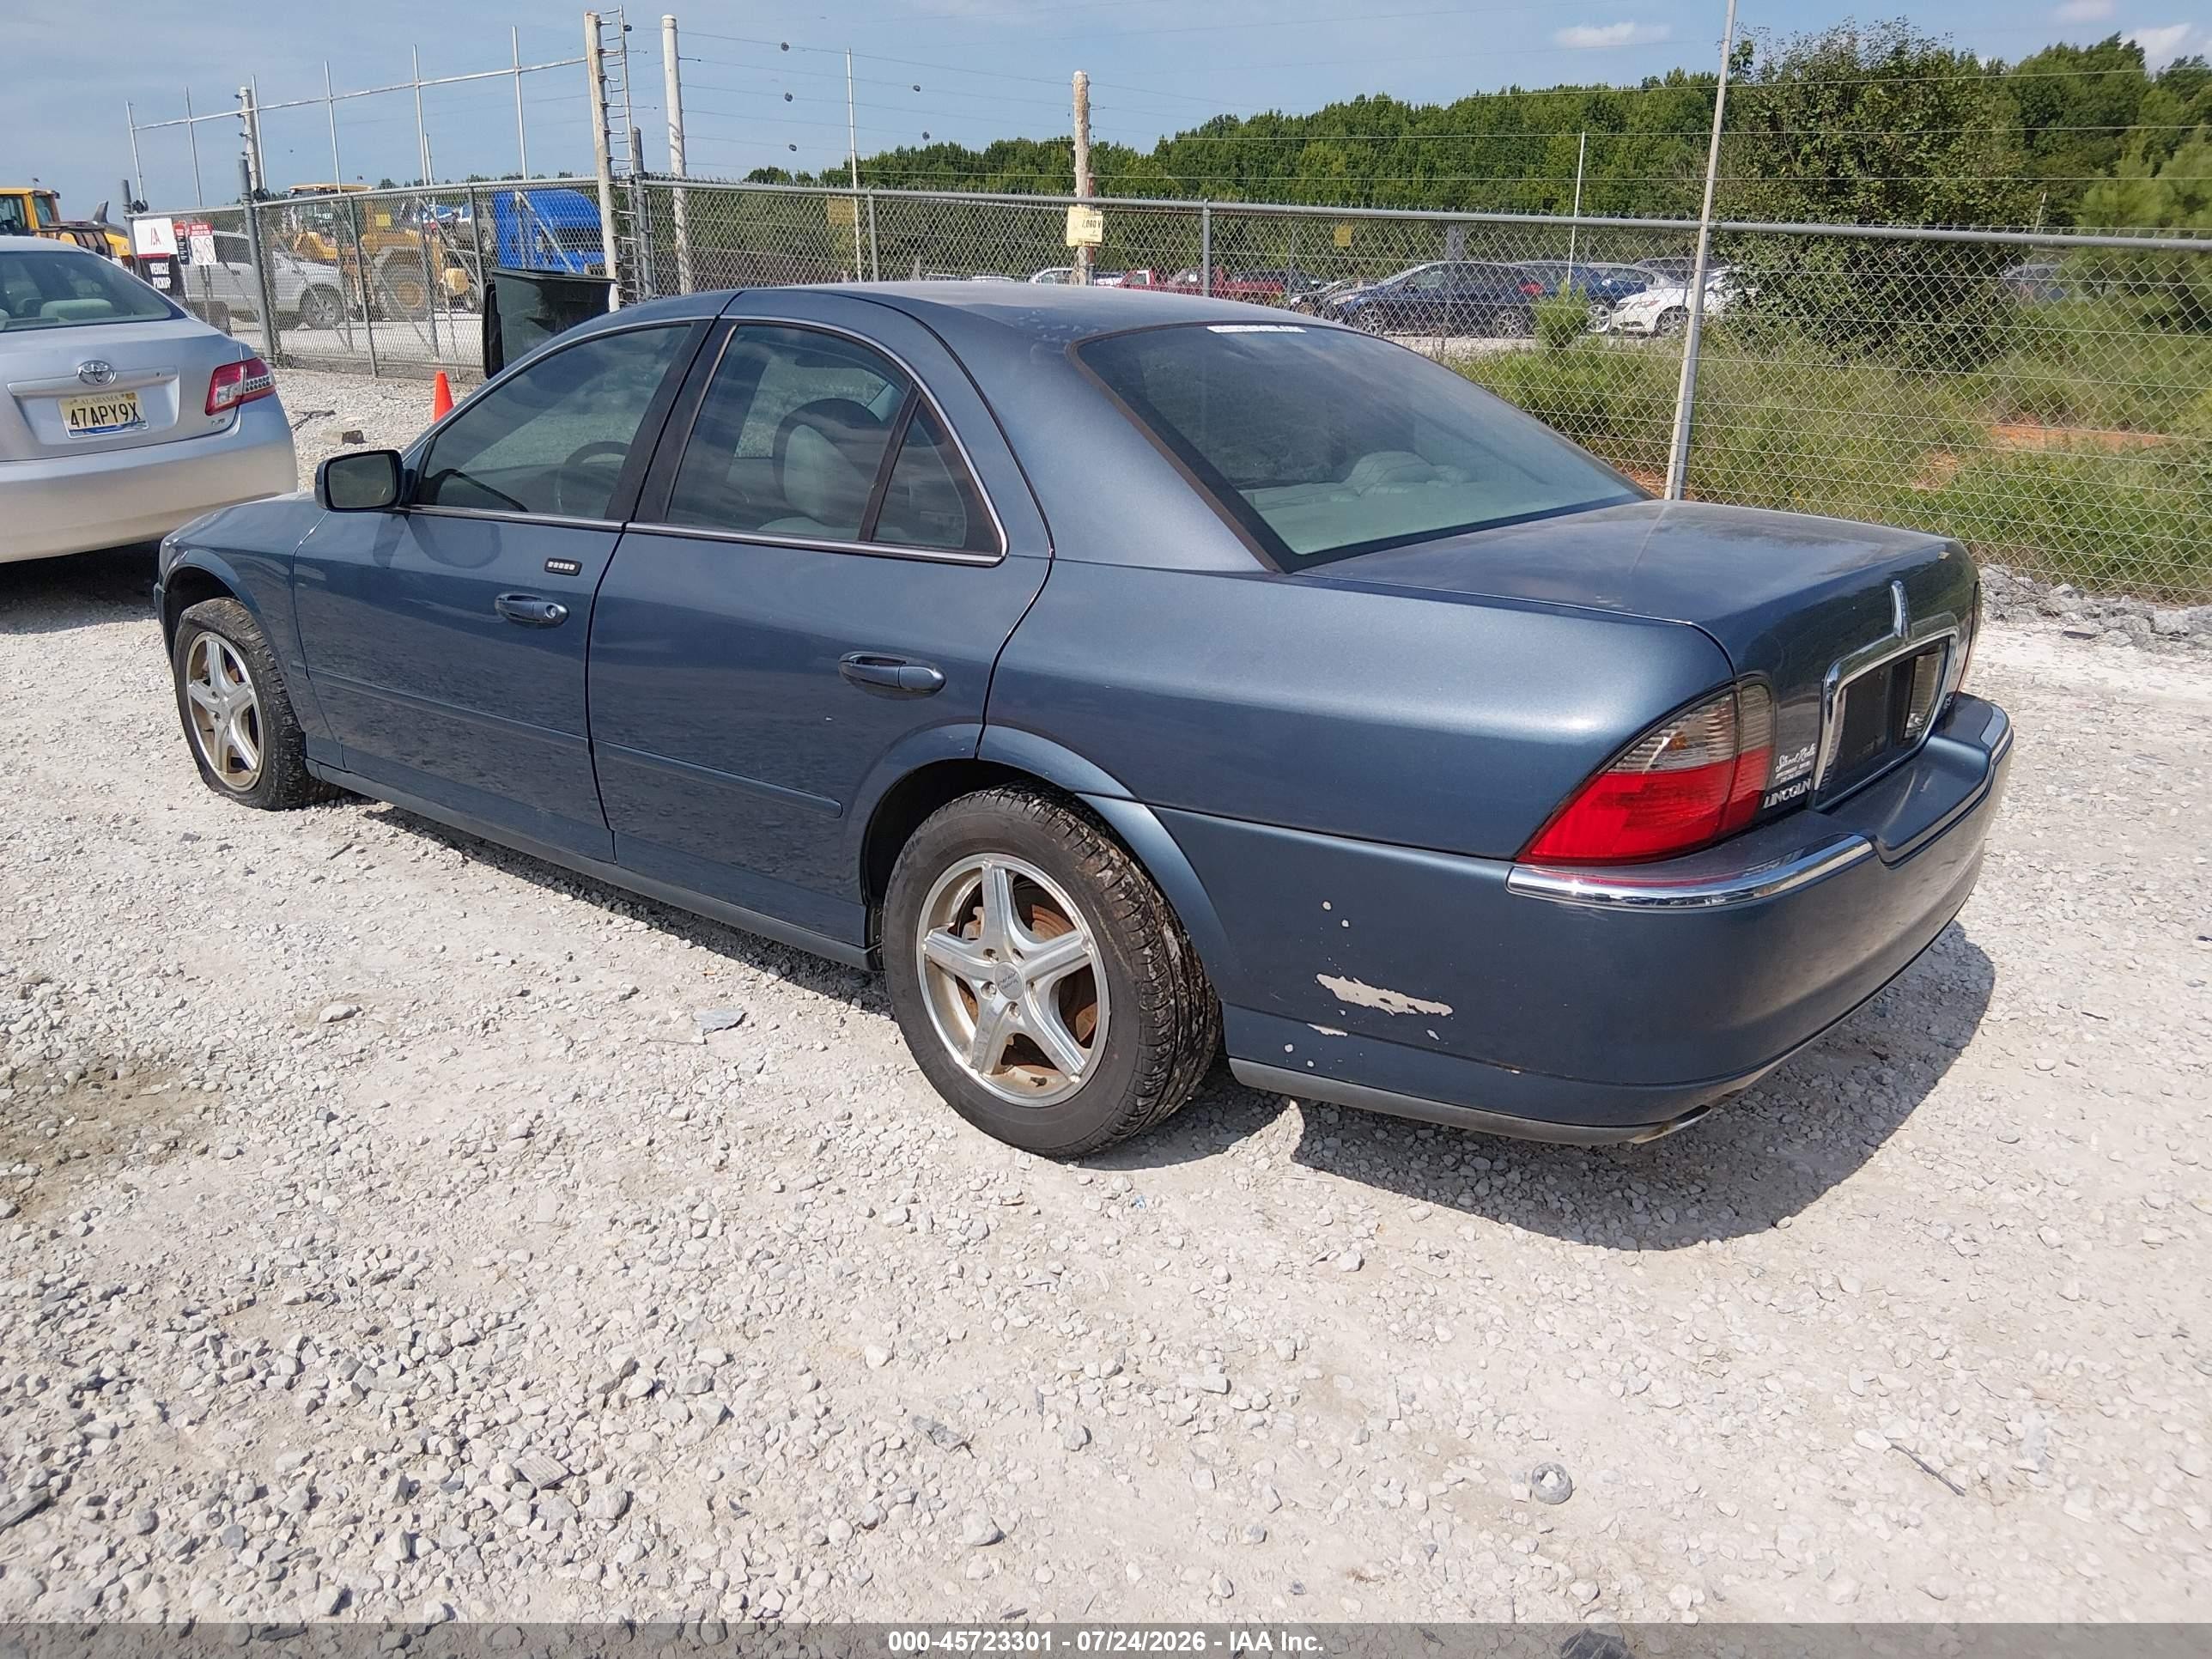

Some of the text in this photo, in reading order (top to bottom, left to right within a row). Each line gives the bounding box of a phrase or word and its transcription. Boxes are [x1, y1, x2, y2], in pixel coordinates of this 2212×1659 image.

[1097, 220, 1102, 228] V
[70, 402, 141, 428] 47APY9X
[1763, 778, 1812, 808] LINCOLN
